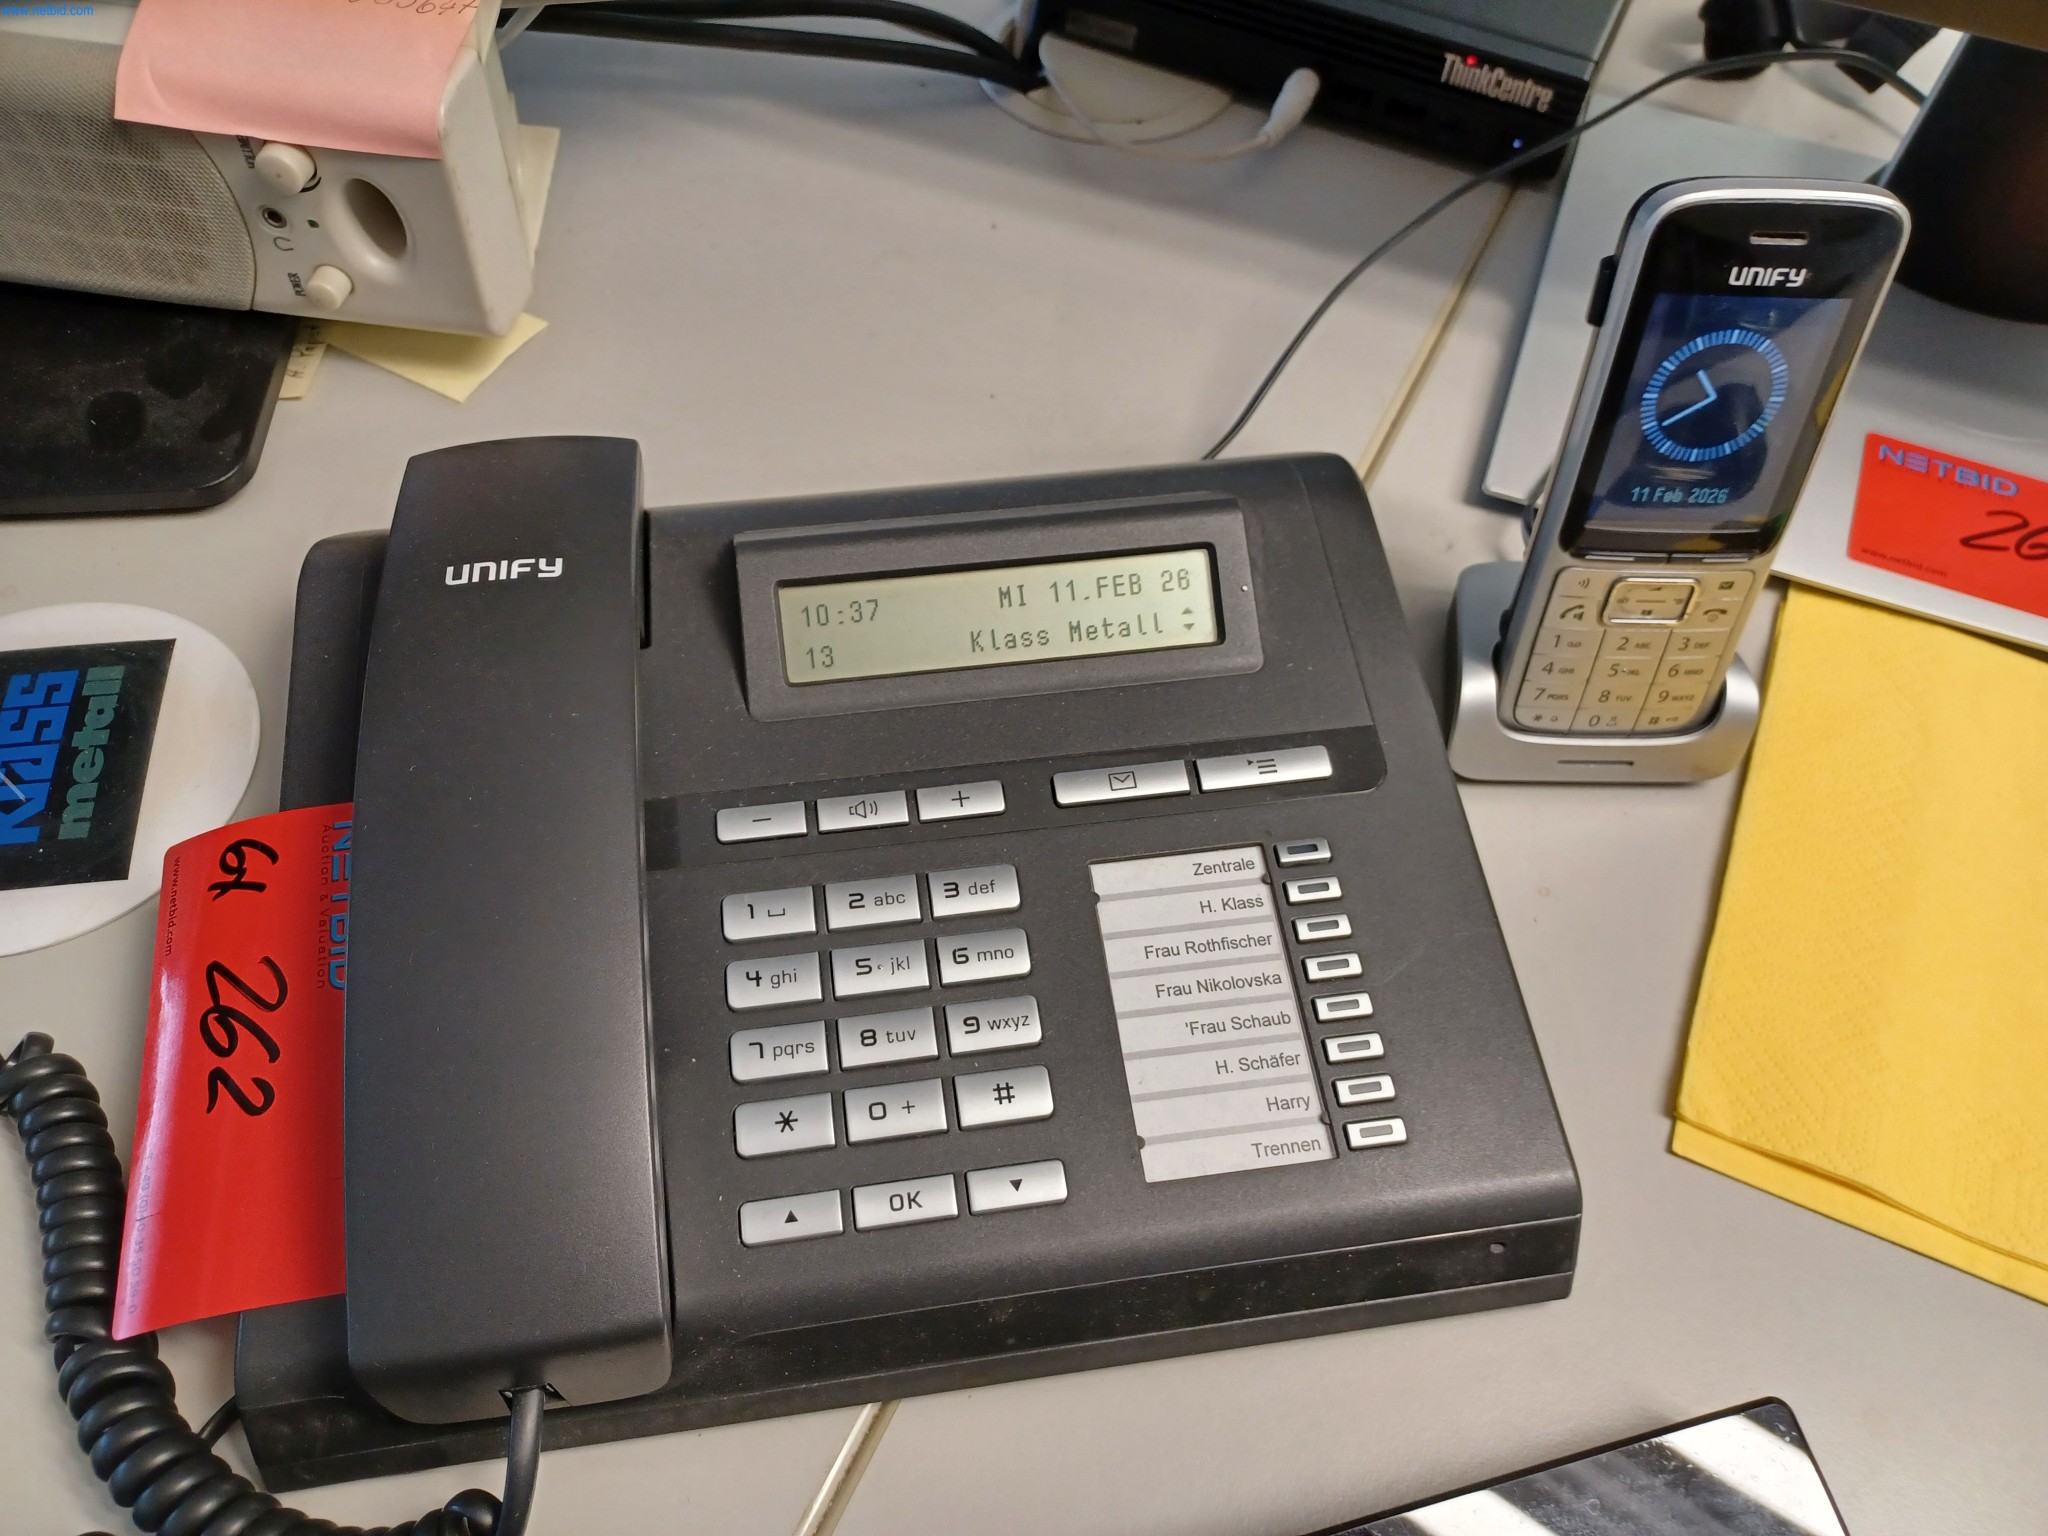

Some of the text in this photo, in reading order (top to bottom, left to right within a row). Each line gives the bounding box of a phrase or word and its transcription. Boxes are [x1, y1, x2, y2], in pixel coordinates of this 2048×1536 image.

[1440, 52, 1554, 113] ThinkCentre
[1878, 444, 2019, 497] NETBID
[1631, 487, 1729, 503] 11 Feb 2026
[800, 568, 1191, 628] 10:37 MI 11.FEB 26
[805, 612, 1165, 670] 13 Klass Metall
[1616, 637, 1629, 651] 2
[1678, 637, 1691, 651] 3
[1541, 662, 1554, 675] 4
[1668, 663, 1680, 678] 6
[1598, 689, 1611, 703] 8
[1657, 690, 1670, 703] 9
[58, 665, 126, 840] metall
[321, 824, 333, 886] Auction
[1192, 858, 1256, 877] Zentrale
[943, 879, 996, 899] 3 def
[164, 856, 181, 957] www.netbid.com
[848, 891, 907, 910] 2 abc
[1199, 895, 1265, 915] H. Klass
[317, 908, 330, 989] Valuation
[951, 946, 1015, 965] 6 mno
[1144, 933, 1274, 960] Frau Rothfischer
[855, 955, 911, 977] 5 jkl
[745, 968, 798, 990] 4 ghi
[1155, 972, 1283, 999] Frau Nikolovska
[962, 1014, 1031, 1035] 9 wxyz
[1231, 1011, 1292, 1031] Schaub
[200, 956, 289, 1117] 262
[860, 1029, 917, 1048] 8 tuv
[749, 1041, 815, 1062] 7 pqrs
[1215, 1052, 1302, 1075] H. Schäfer
[1266, 1094, 1312, 1114] Harry
[1251, 1138, 1322, 1159] Trennen
[889, 1190, 924, 1213] OK
